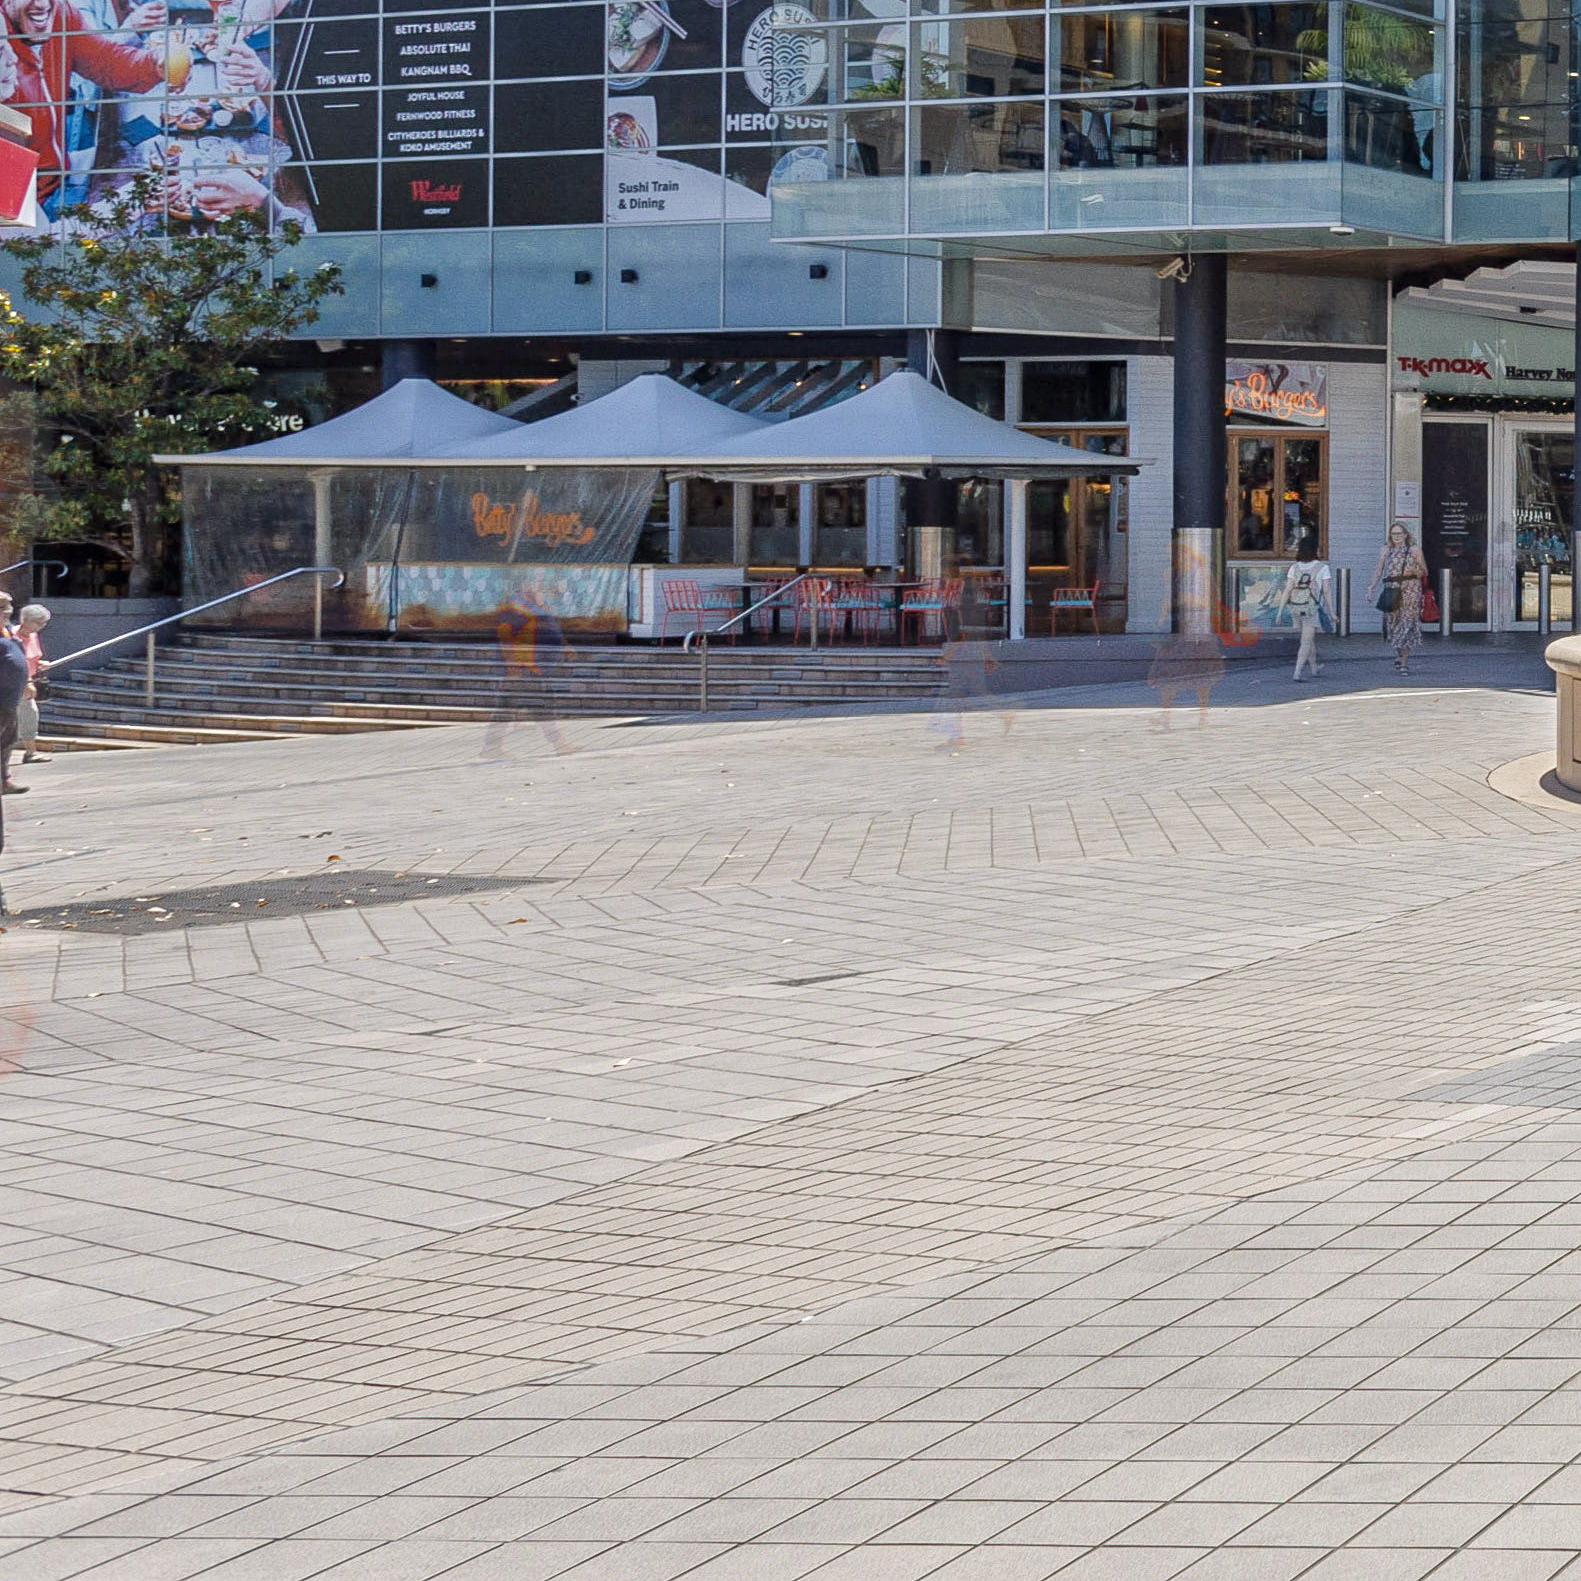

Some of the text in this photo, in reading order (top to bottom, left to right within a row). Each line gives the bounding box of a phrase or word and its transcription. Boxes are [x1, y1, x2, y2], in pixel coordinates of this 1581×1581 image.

[395, 21, 477, 35] BETTY'S BURGERS
[747, 10, 779, 51] HERO
[400, 43, 471, 56] ABSOLUTE THAI
[401, 64, 472, 77] KANGNAM BBQ
[316, 74, 372, 86] THIS WAY TO
[407, 91, 465, 102] JOYFUL HOUSE
[396, 109, 476, 122] FERNWOOD FITNESS
[727, 113, 779, 132] HERO
[388, 129, 484, 141] CITYHEROES BILLIARDS &
[400, 141, 472, 153] KOKO AMUSEMENT
[410, 179, 462, 202] Westfield
[618, 180, 679, 194] Sushi Train
[618, 198, 665, 211] & Dining
[1505, 366, 1553, 380] Harvey
[1247, 372, 1326, 419] Burgers
